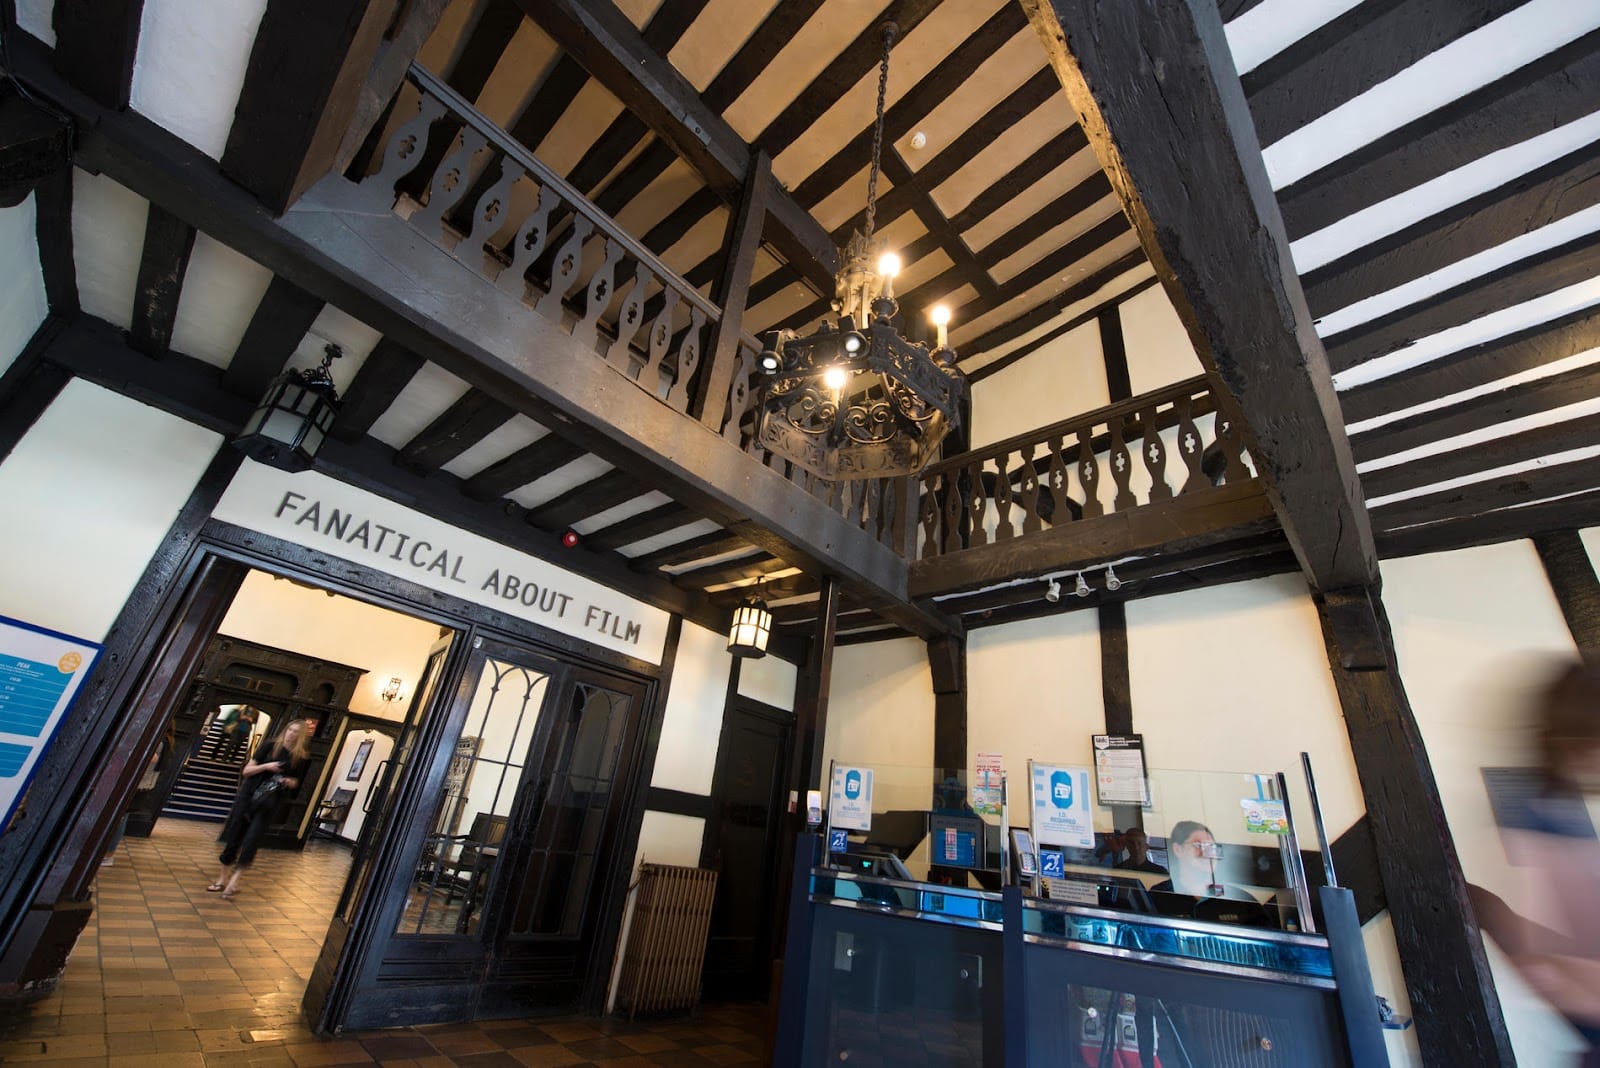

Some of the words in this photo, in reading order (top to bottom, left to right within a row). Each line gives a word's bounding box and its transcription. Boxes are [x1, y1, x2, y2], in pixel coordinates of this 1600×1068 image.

[275, 491, 466, 583] FANATICAL
[481, 568, 573, 617] ABOUT
[584, 605, 641, 645] FILM
